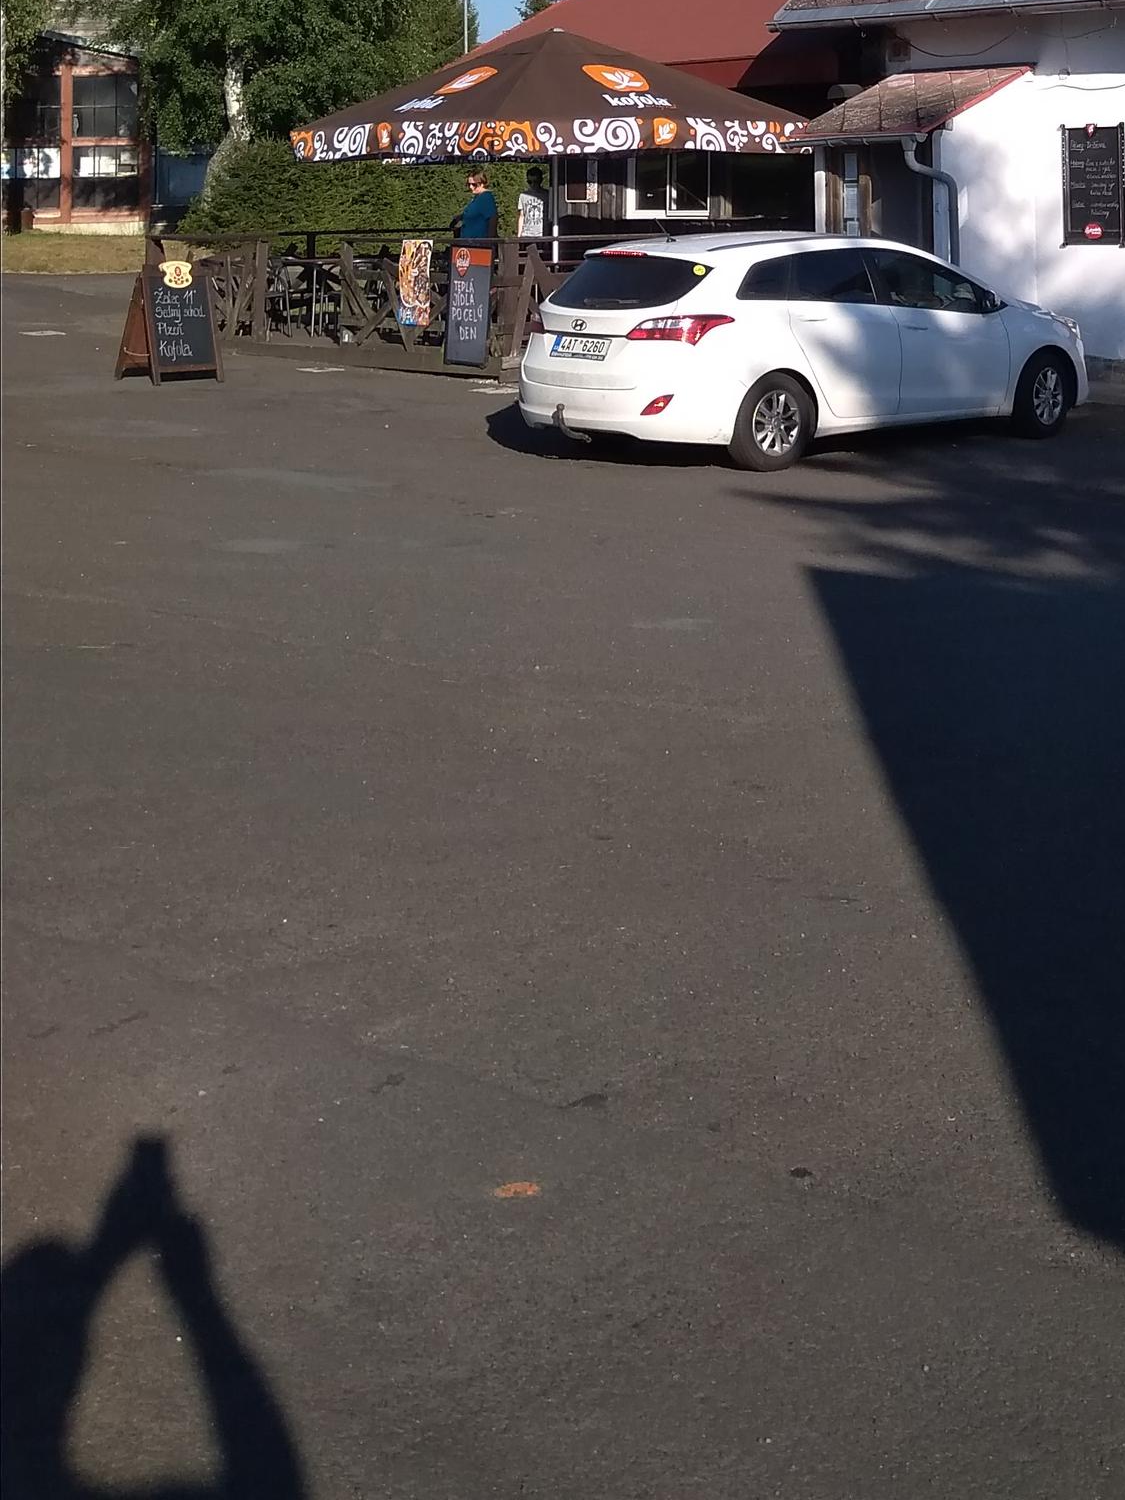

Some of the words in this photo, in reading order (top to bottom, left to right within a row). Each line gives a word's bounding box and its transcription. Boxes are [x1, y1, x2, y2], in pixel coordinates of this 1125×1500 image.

[602, 92, 673, 109] kofola
[453, 278, 475, 293] TEPLÁ
[452, 292, 475, 306] JÍDLA
[459, 325, 477, 341] DEN
[159, 339, 193, 361] Kofola
